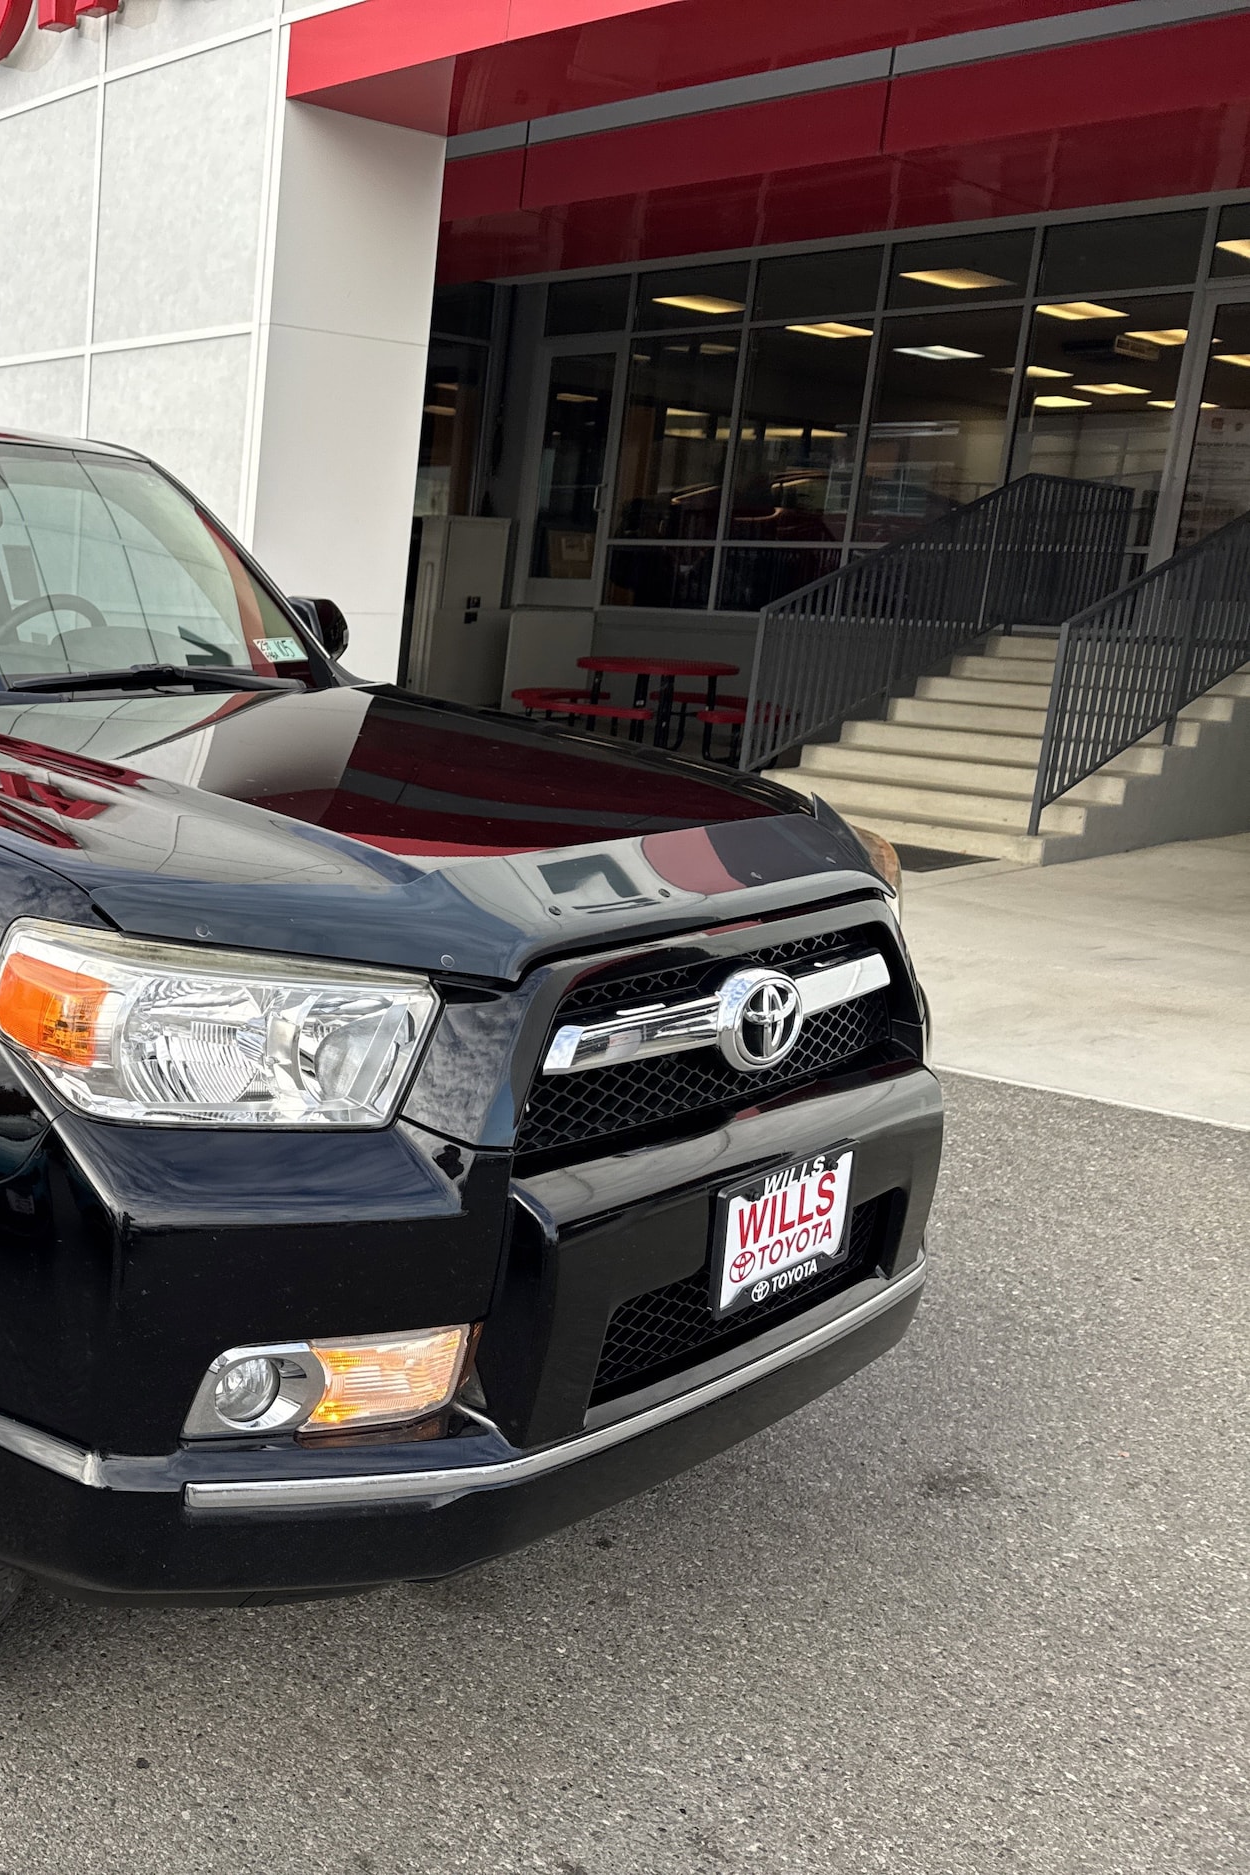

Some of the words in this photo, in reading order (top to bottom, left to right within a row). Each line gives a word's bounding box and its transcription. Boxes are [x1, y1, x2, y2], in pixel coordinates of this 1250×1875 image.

[763, 1156, 826, 1196] WILLS
[738, 1172, 836, 1250] WILLS
[758, 1218, 832, 1270] TOYOTA
[771, 1259, 818, 1293] TOYOTA
